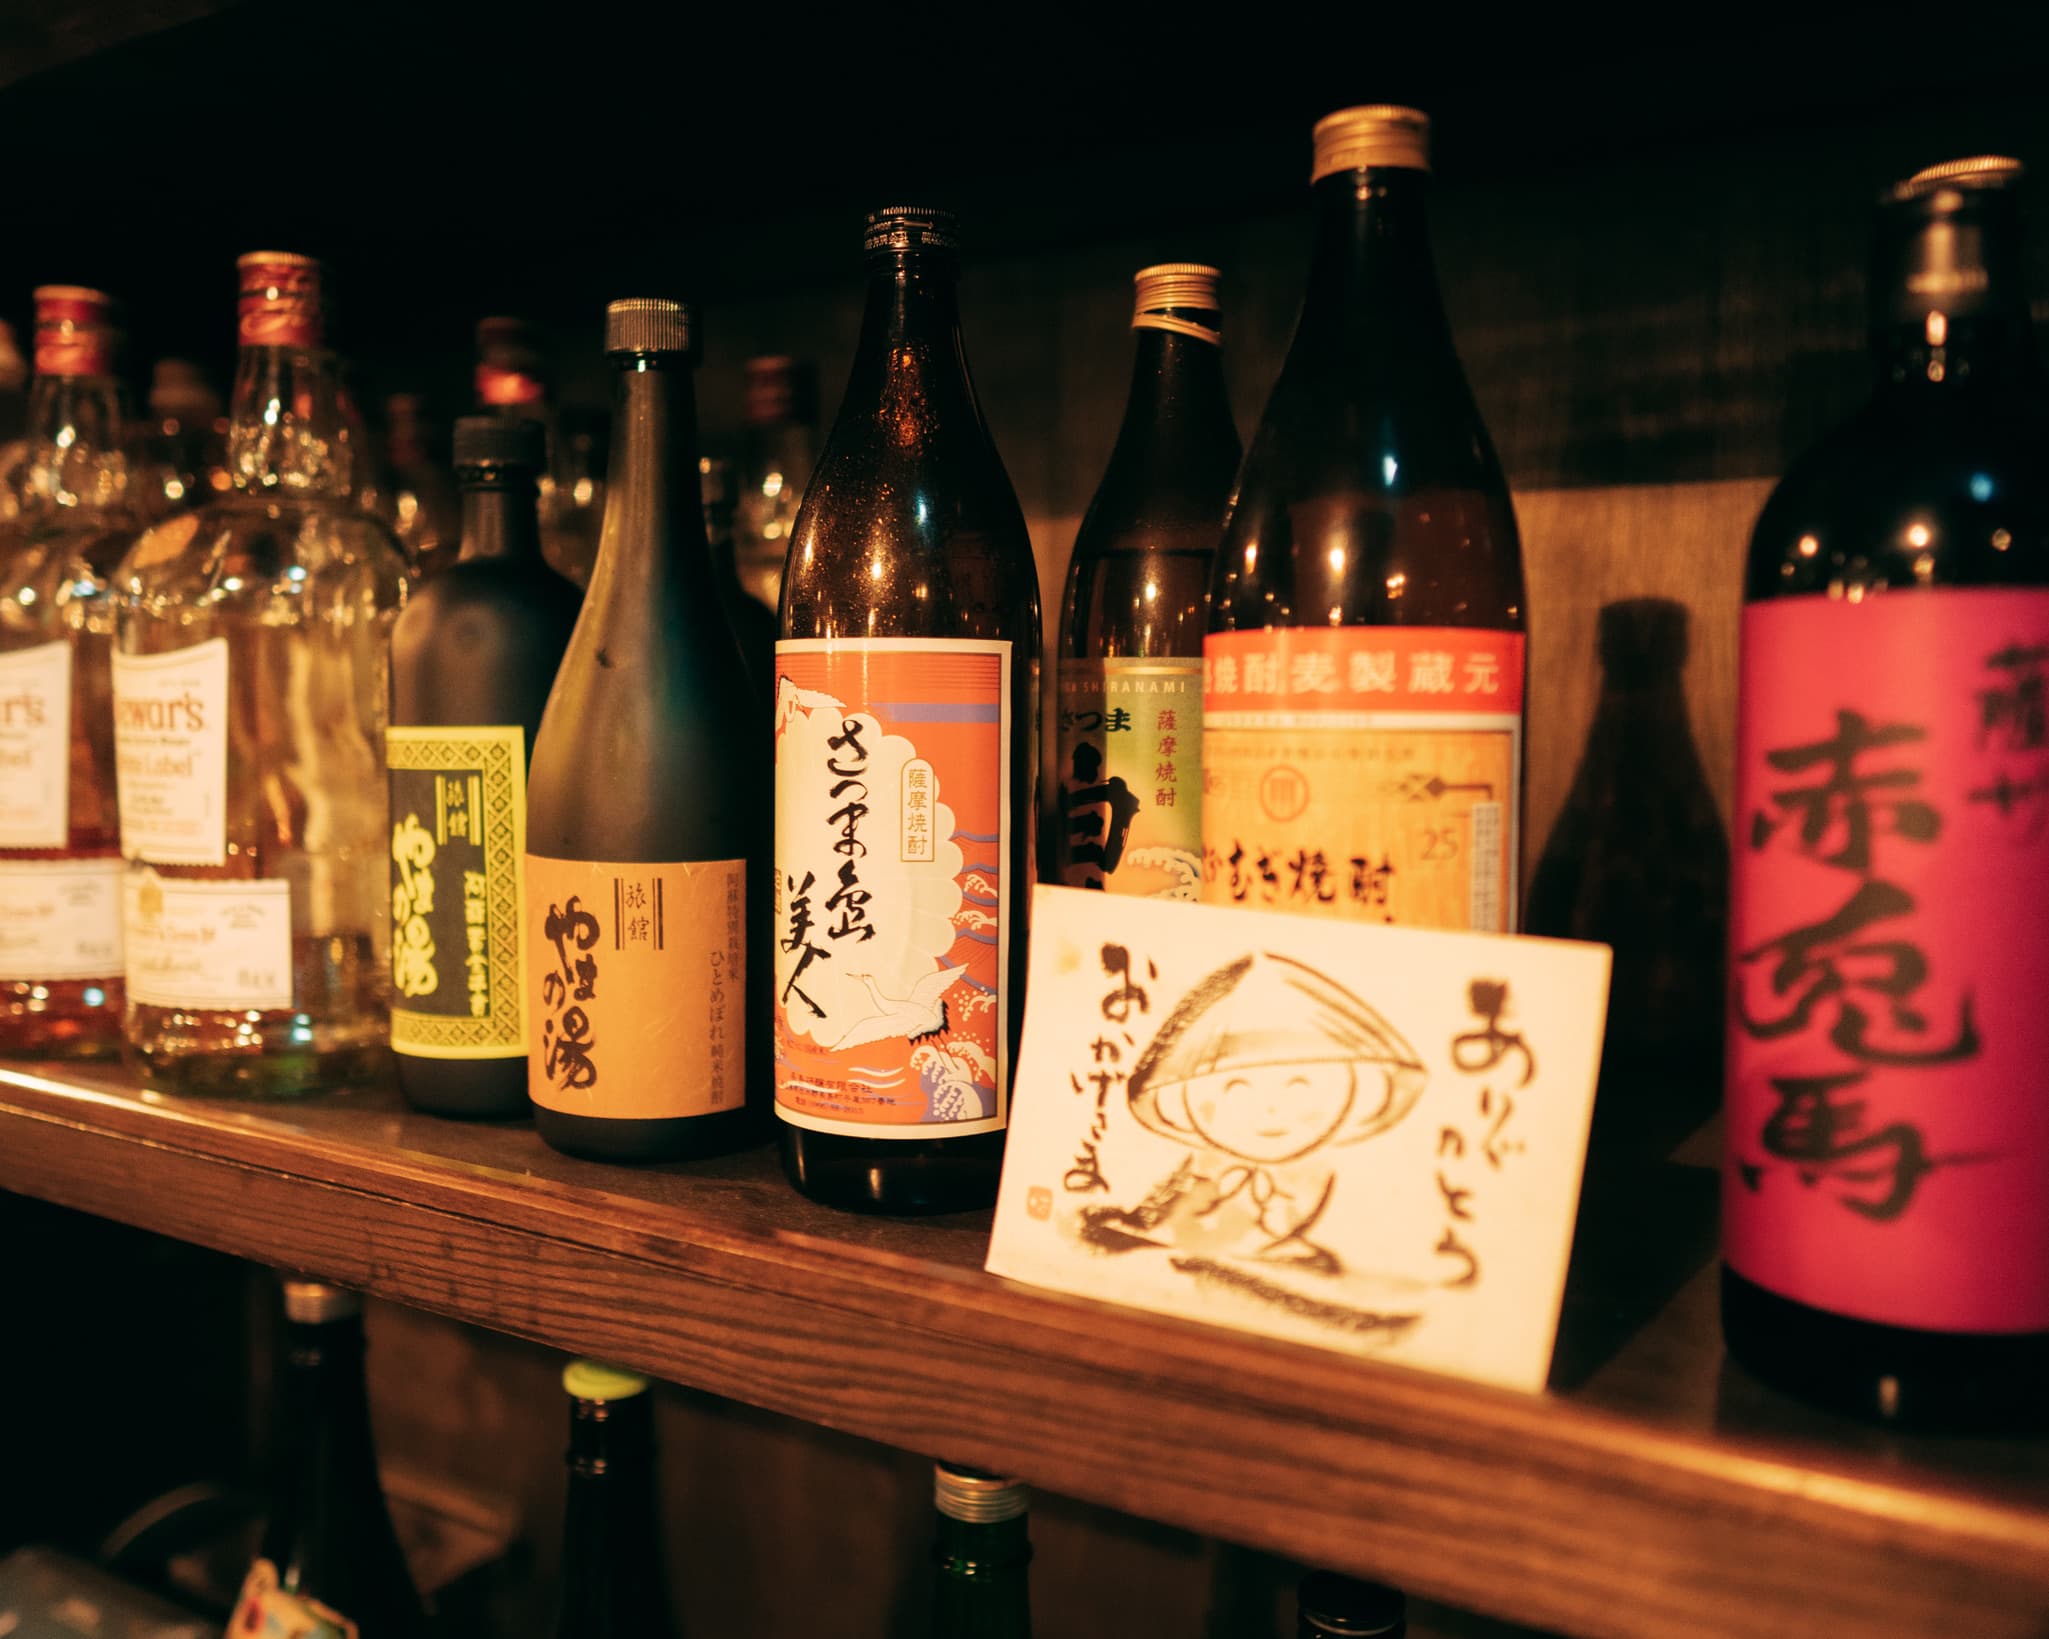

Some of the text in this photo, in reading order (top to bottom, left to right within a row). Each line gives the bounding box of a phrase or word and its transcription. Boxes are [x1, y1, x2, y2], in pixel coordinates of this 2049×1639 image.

[1156, 709, 1177, 807] 薩摩焼酎
[907, 768, 928, 856] 薩摩焼酎
[1057, 741, 1141, 890] 白
[625, 882, 651, 942] 旅館
[543, 895, 601, 1092] やまの湯
